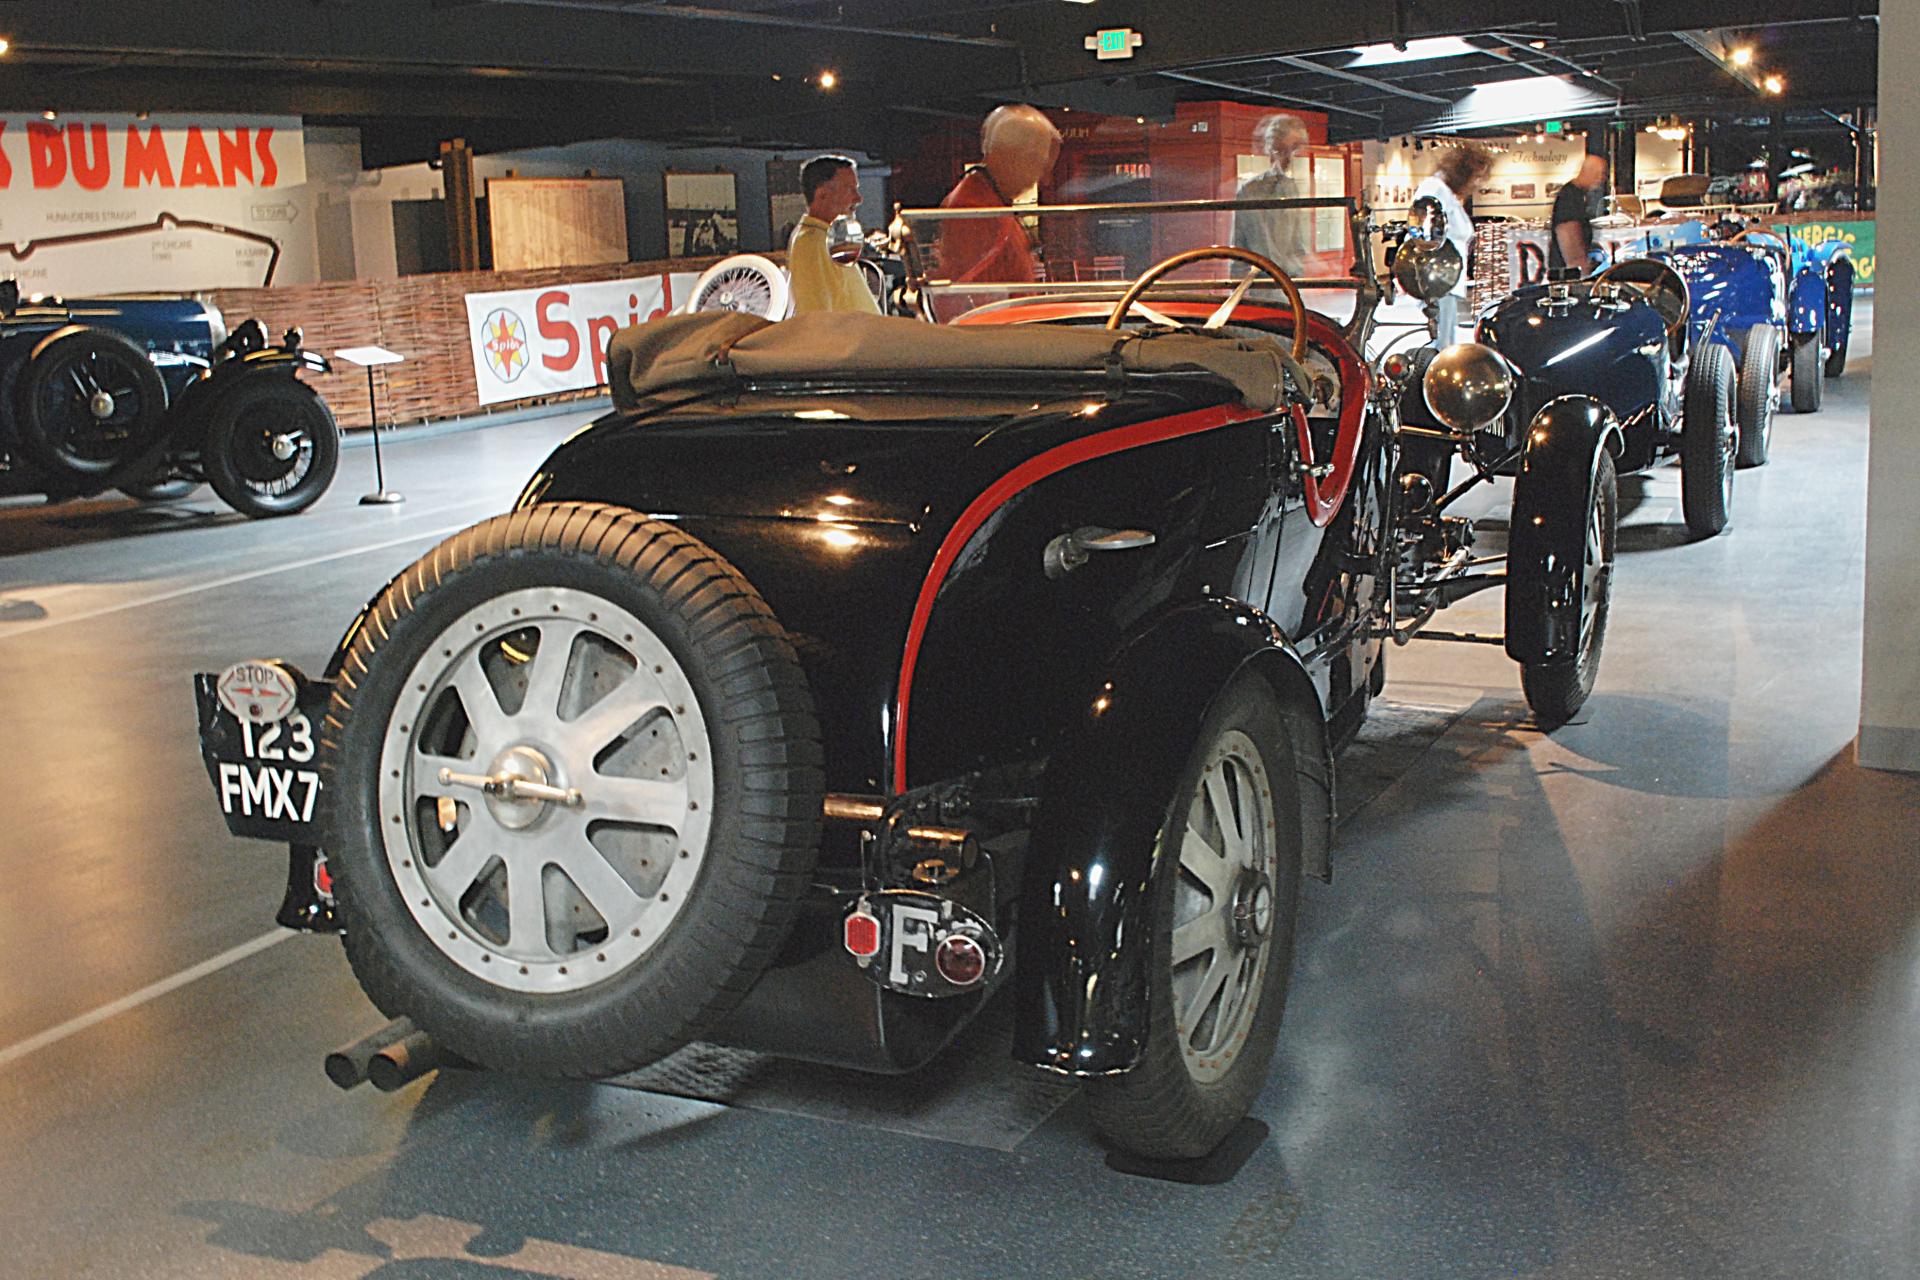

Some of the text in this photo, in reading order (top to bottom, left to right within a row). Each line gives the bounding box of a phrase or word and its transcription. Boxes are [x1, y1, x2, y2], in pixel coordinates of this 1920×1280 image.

[1103, 31, 1125, 51] EXIT
[26, 121, 111, 192] DU
[124, 123, 278, 189] MANS
[1511, 149, 1568, 166] Technology
[236, 667, 274, 686] STOP
[238, 713, 315, 763] 123
